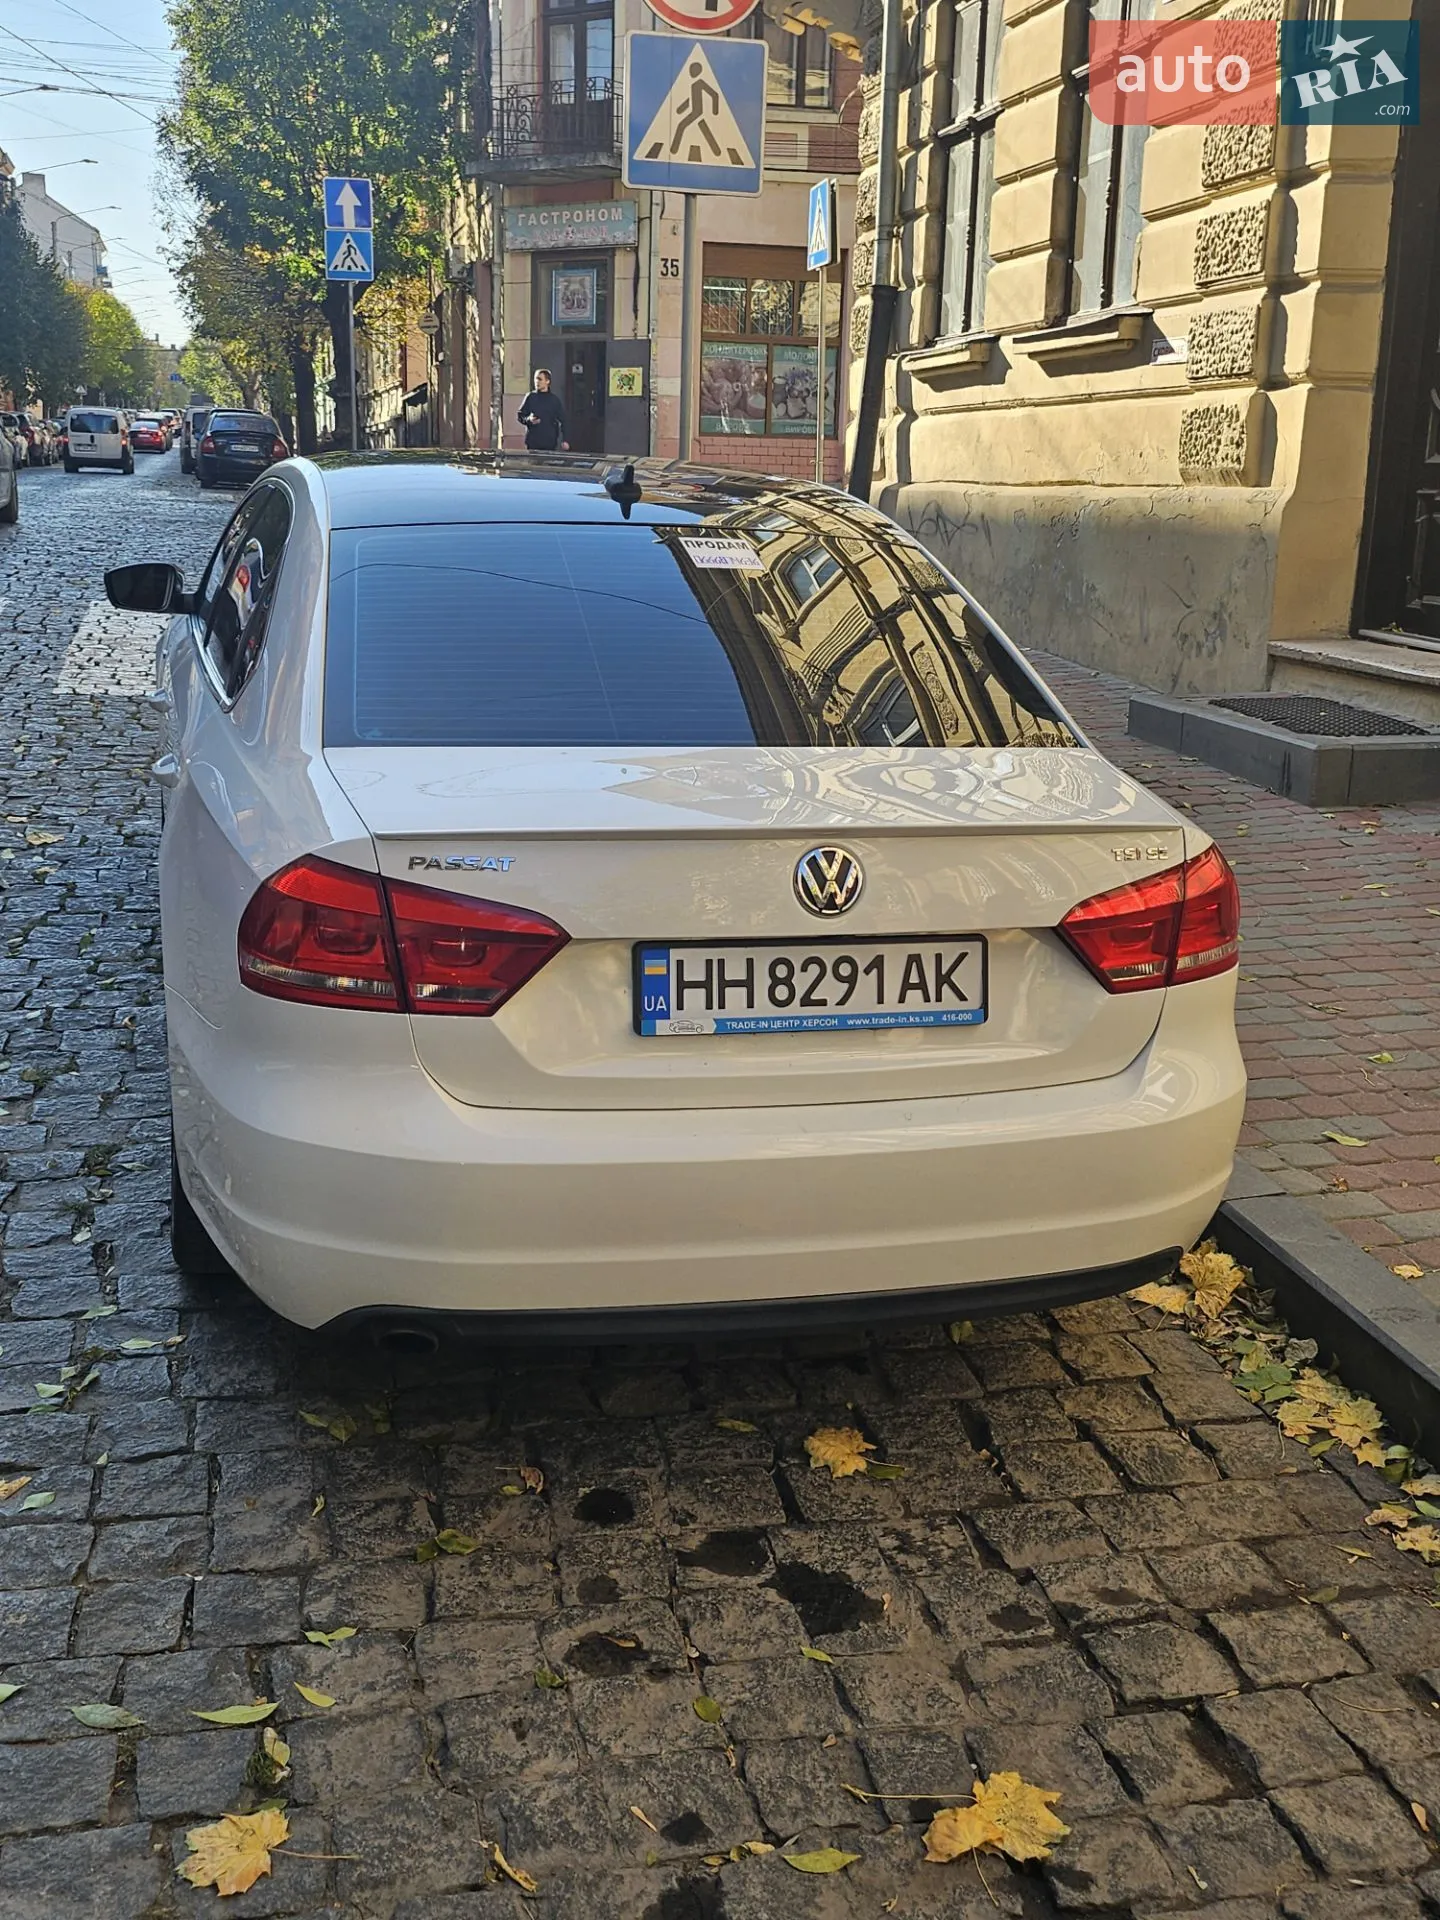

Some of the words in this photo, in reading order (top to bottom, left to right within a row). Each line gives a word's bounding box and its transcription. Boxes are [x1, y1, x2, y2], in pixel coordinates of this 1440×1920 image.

[517, 207, 623, 226] ГАСТРОНОМ
[660, 258, 680, 277] 35
[683, 540, 750, 552] ПРОДАМ
[408, 856, 516, 872] PASSAT
[676, 957, 755, 1010] HH
[767, 954, 885, 1008] 8291
[897, 951, 969, 1004] AK
[644, 995, 667, 1011] UA
[726, 1020, 768, 1030] TRADE-IN
[771, 1019, 800, 1029] ЦЕНТР
[802, 1018, 838, 1027] ХЕРСОН
[847, 1015, 934, 1026] www.trade-in.ks.ua
[942, 1013, 973, 1021] 416-000
